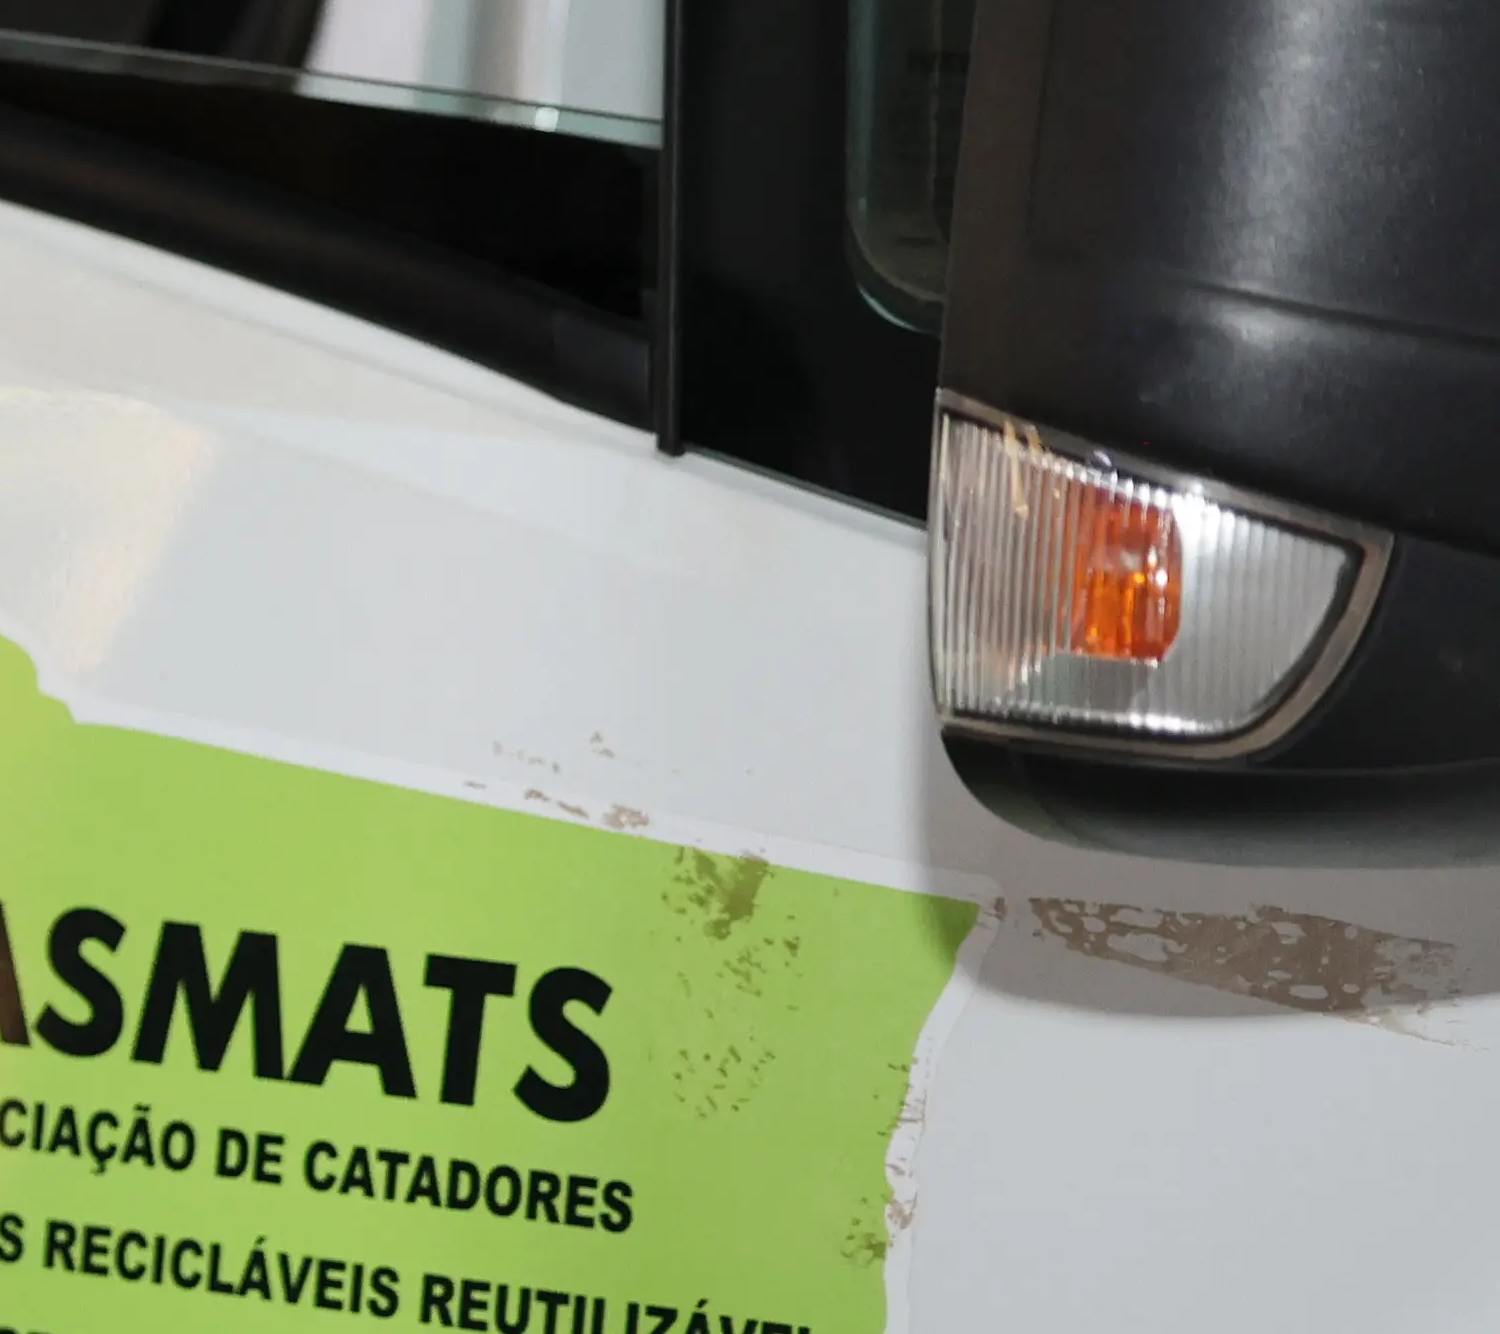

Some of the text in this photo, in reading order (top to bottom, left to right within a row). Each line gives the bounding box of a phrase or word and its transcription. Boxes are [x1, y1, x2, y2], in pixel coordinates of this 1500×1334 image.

[215, 1128, 285, 1185] DE
[304, 1140, 633, 1234] CATADORES
[43, 1219, 400, 1319] RECICLÁVEIS
